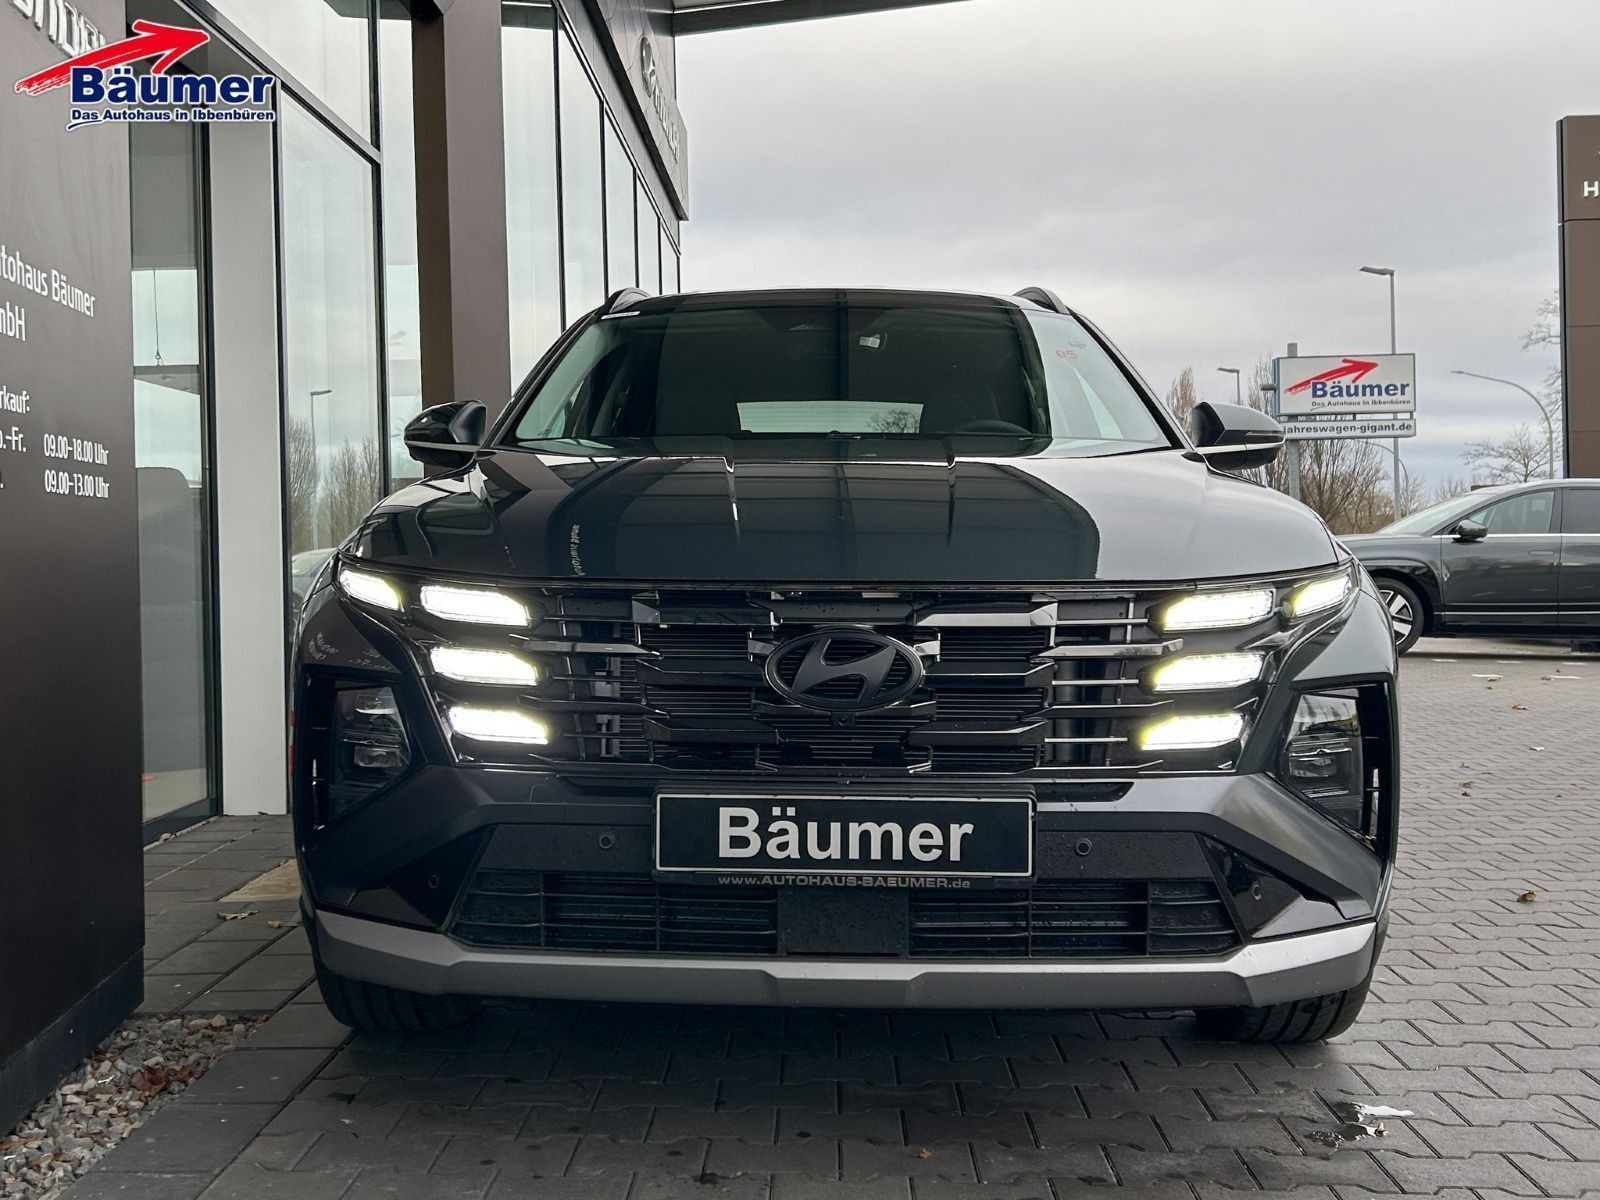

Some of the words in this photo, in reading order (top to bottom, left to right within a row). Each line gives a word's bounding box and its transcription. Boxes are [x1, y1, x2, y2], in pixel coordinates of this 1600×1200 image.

[0, 245, 48, 297] tohaus
[51, 269, 96, 318] Bäumer
[1311, 380, 1410, 399] Bäumer
[94, 442, 109, 465] Uhr
[95, 476, 110, 498] Uhr
[718, 805, 974, 862] Bäumer
[717, 875, 971, 889] www.AUTOHAUS-BAEUMER.de
